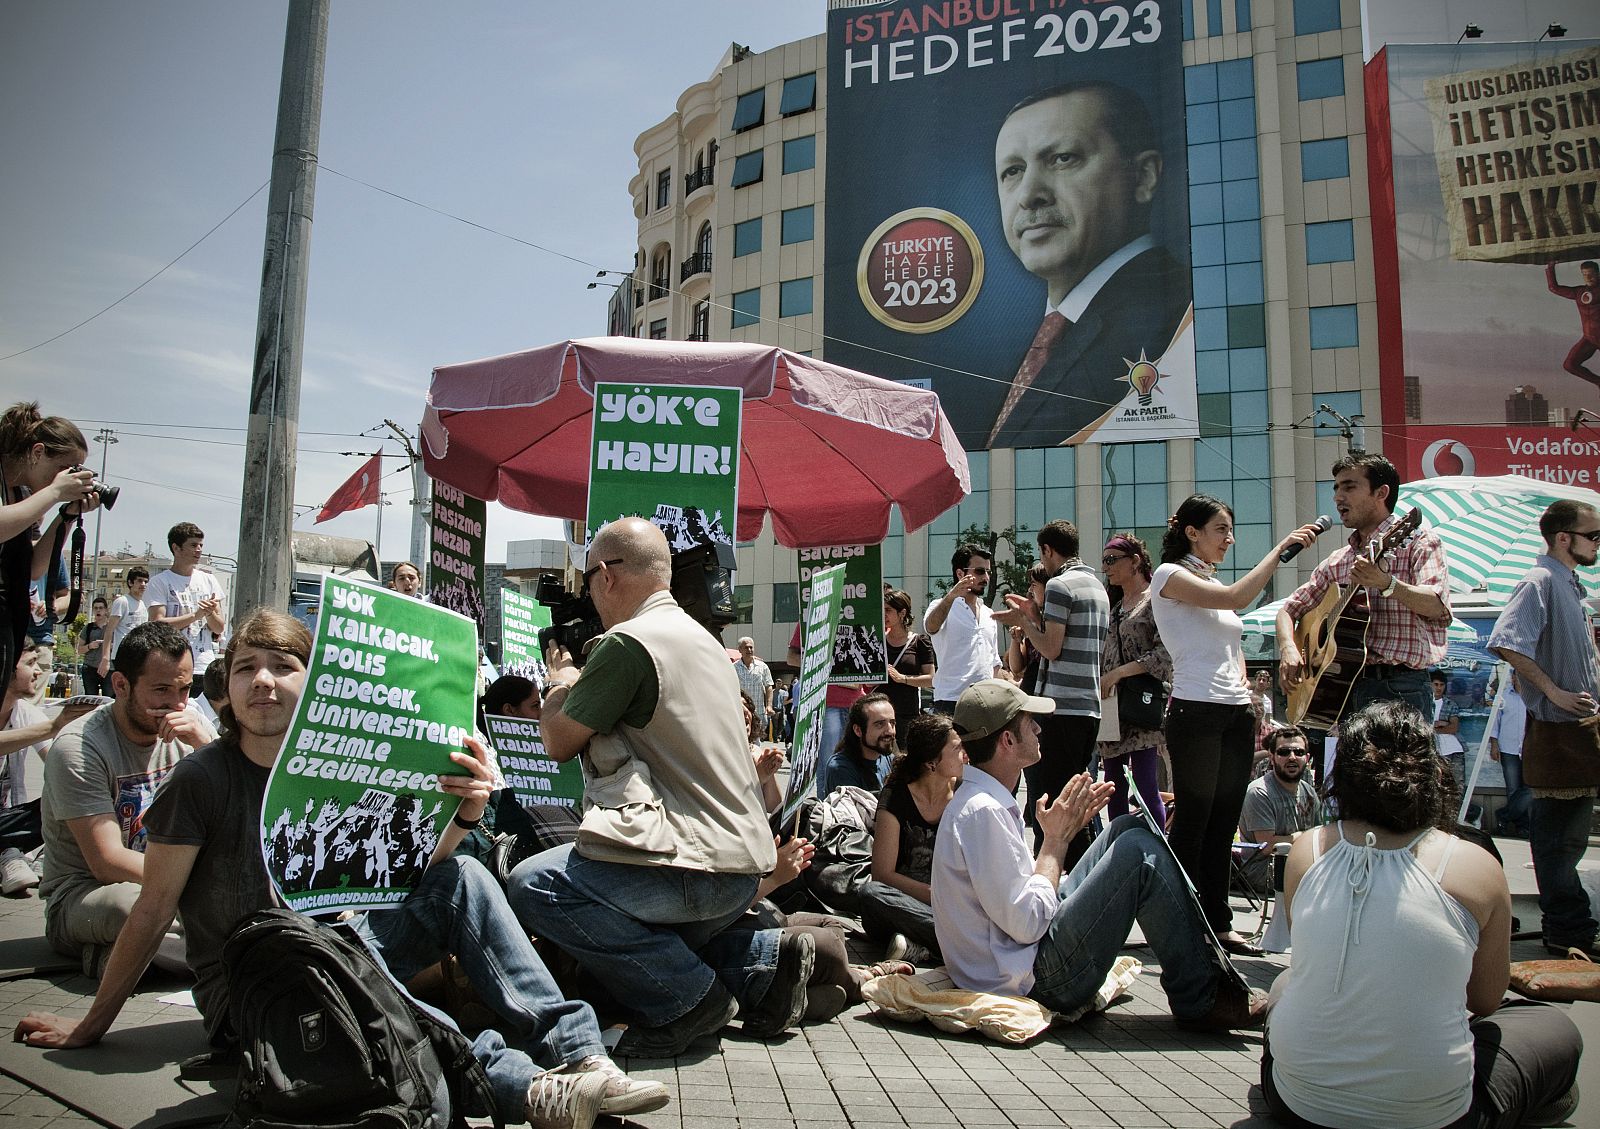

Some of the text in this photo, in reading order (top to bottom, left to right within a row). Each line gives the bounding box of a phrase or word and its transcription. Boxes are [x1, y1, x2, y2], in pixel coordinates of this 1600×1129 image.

[844, 0, 1162, 88] HEDEF 2023
[1444, 57, 1599, 104] ULUSLARARASI
[885, 251, 954, 268] HAZIR
[885, 264, 954, 281] HEDEF
[883, 278, 957, 307] 2023
[1123, 409, 1138, 417] AK
[1506, 436, 1599, 456] Vodafon
[1507, 464, 1590, 486] Türkiye
[332, 586, 377, 618] YÖK
